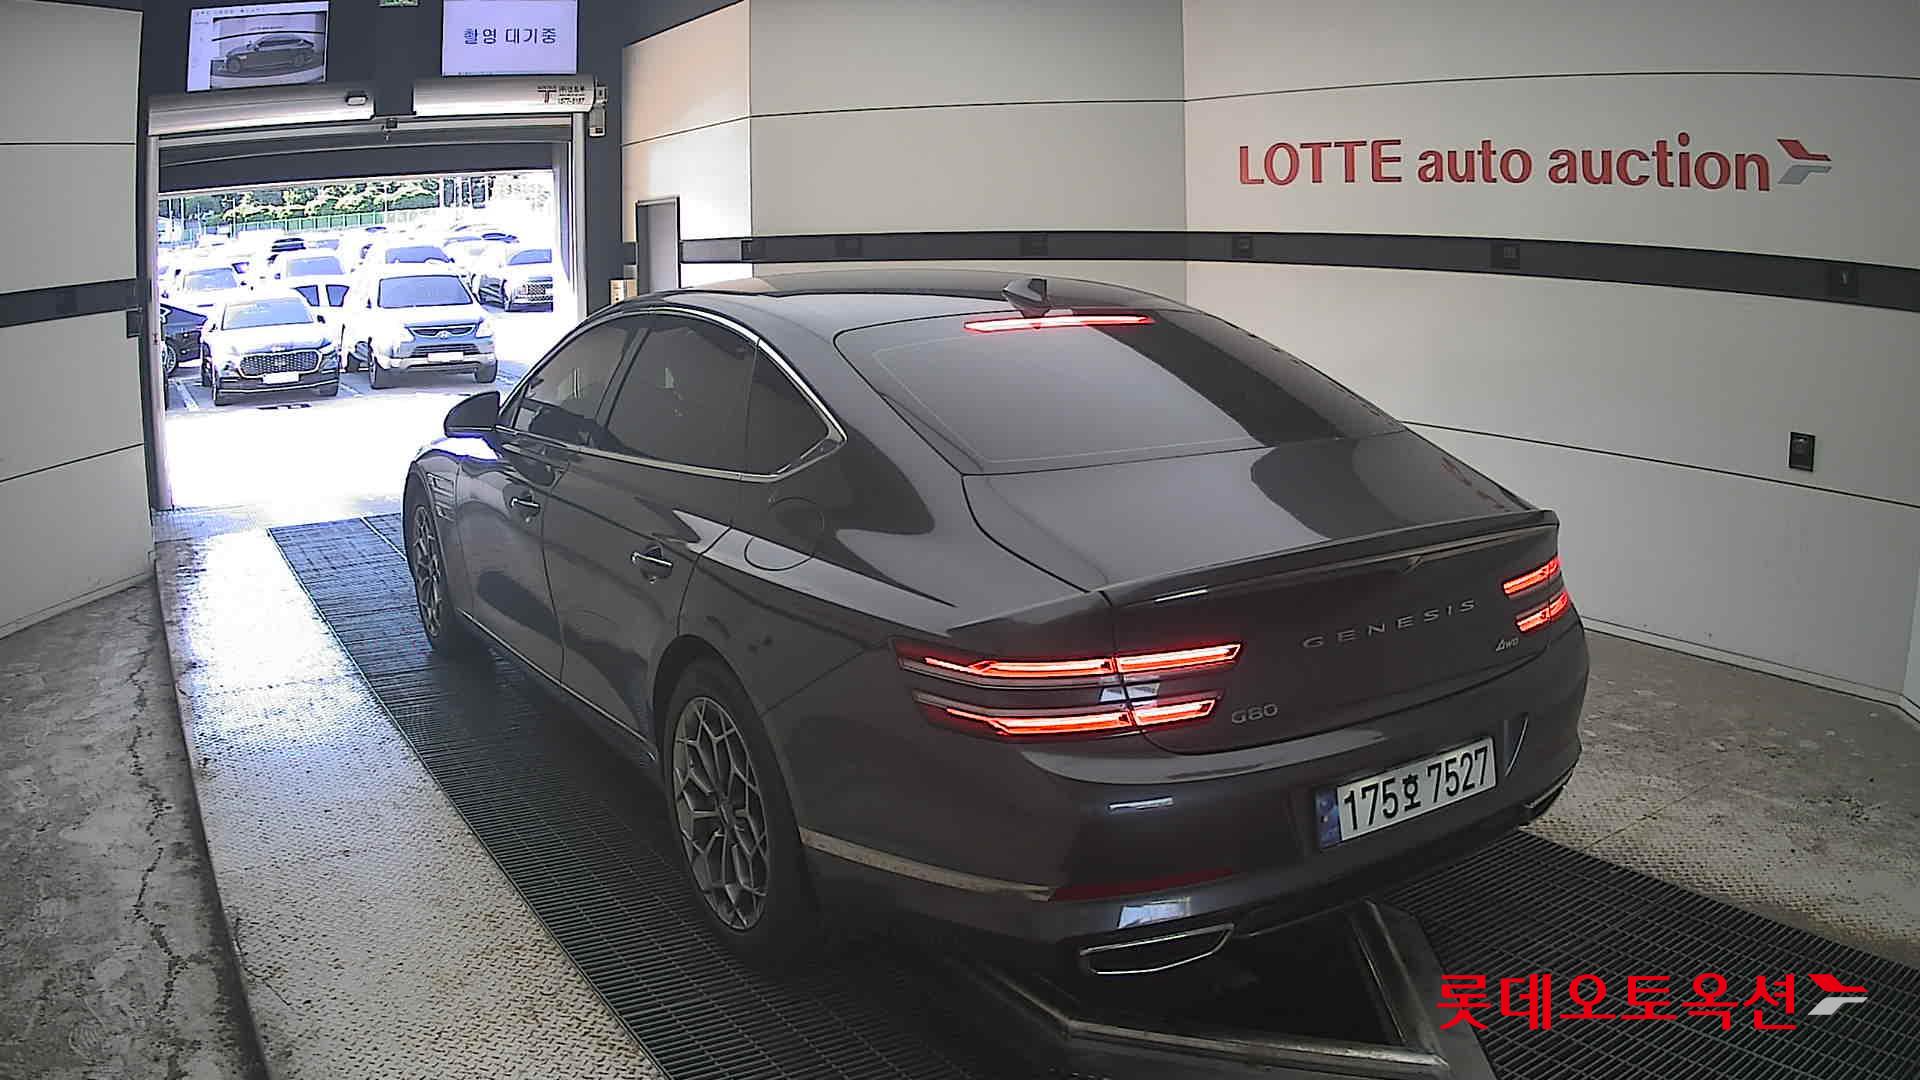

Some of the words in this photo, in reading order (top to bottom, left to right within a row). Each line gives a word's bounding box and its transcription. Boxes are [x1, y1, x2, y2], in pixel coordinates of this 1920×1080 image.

[464, 28, 497, 45] 촬영
[505, 28, 557, 45] 대기중
[1239, 139, 1401, 186] LOTTE
[1417, 141, 1533, 184] auto
[1548, 132, 1771, 191] auction
[1303, 599, 1476, 649] GENESIS
[1231, 703, 1279, 724] G80
[1343, 774, 1421, 830] 175호
[1427, 746, 1488, 803] 7527
